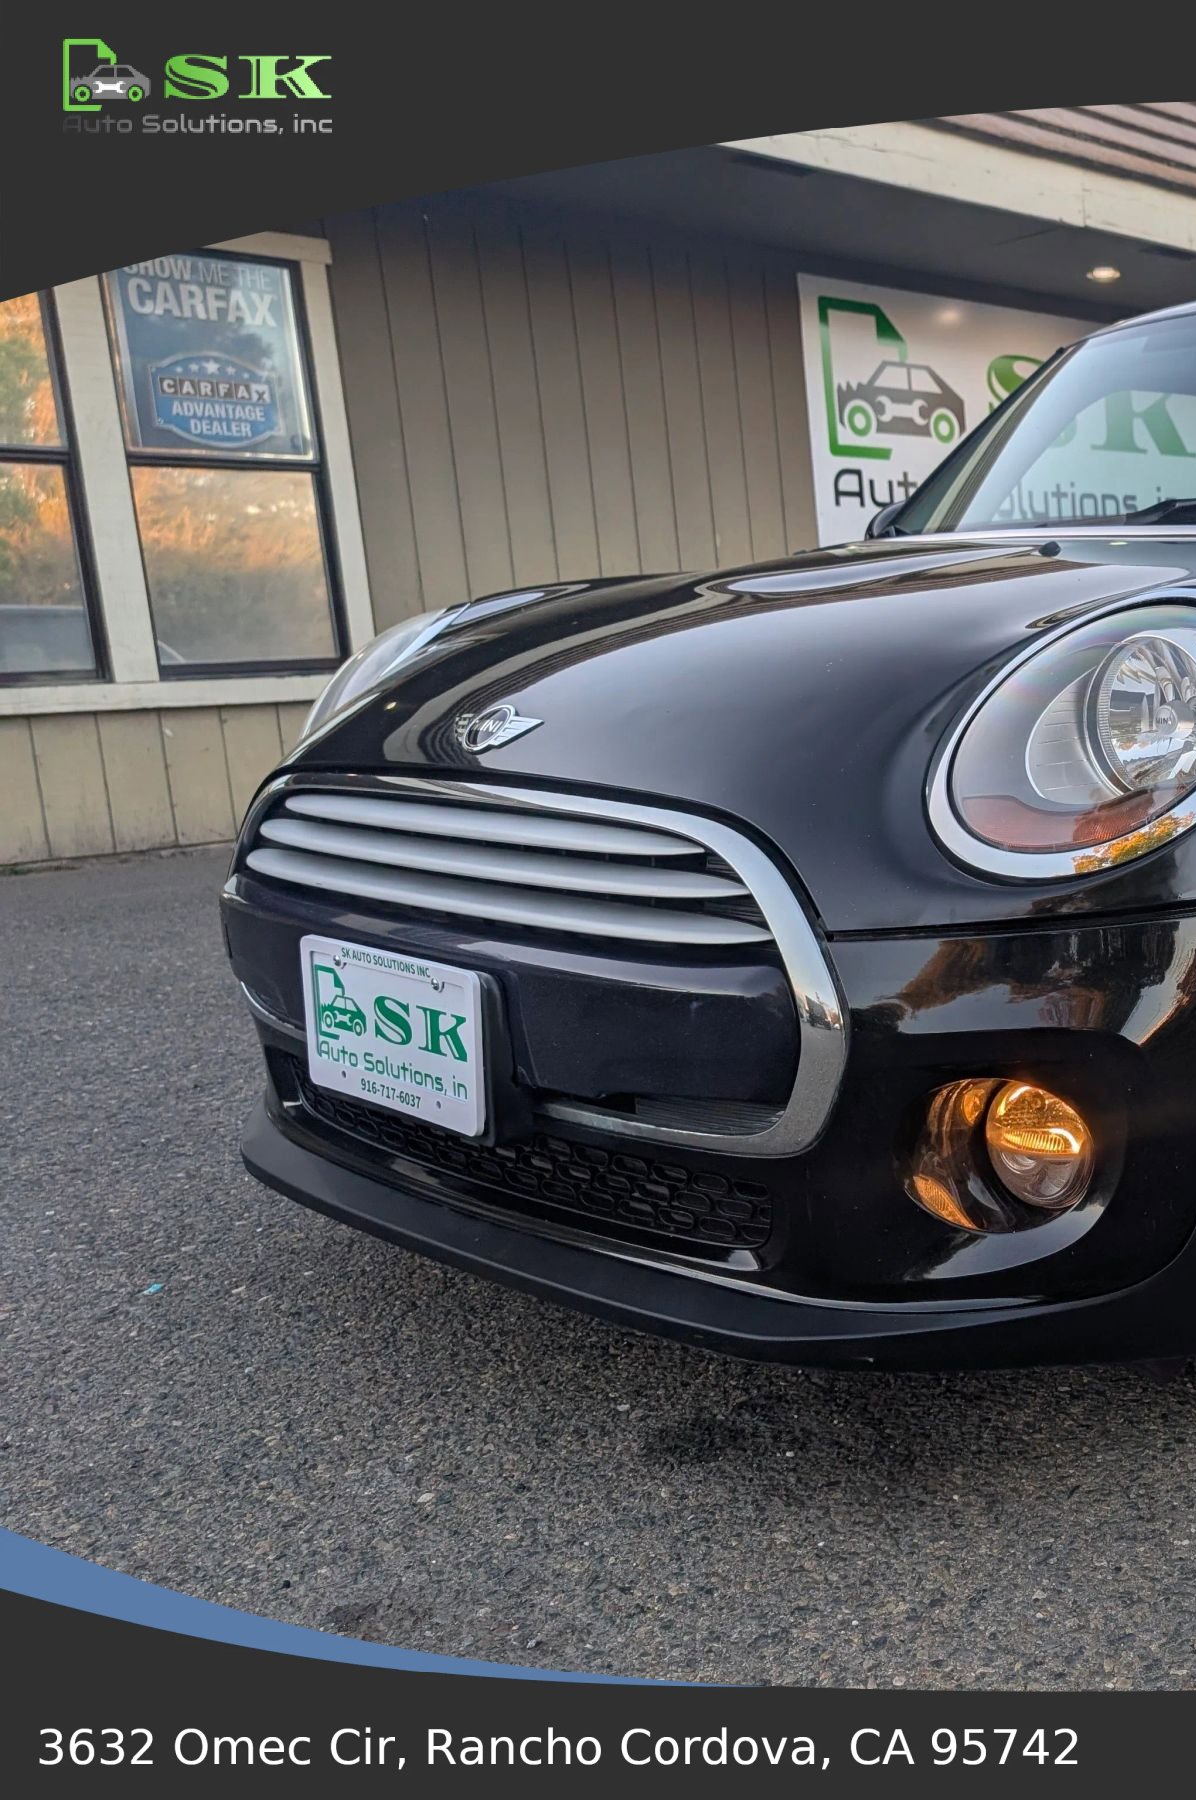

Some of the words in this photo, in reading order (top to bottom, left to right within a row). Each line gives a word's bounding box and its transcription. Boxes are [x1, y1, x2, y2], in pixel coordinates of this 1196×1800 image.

[200, 262, 230, 287] ME
[234, 267, 272, 291] THE
[128, 277, 277, 328] CARFAX
[162, 378, 268, 403] CARFAX
[172, 401, 266, 422] ADVANTAGE
[190, 419, 252, 438] DEALER
[834, 468, 918, 508] Aut
[341, 947, 352, 959] SK
[352, 950, 372, 964] AUTO
[373, 955, 416, 975] SOLUTIONS
[416, 963, 431, 978] INC
[373, 995, 468, 1063] SK
[319, 1040, 359, 1068] Auto
[363, 1052, 448, 1096] Solutions,
[360, 1077, 422, 1109] 916-717-6037
